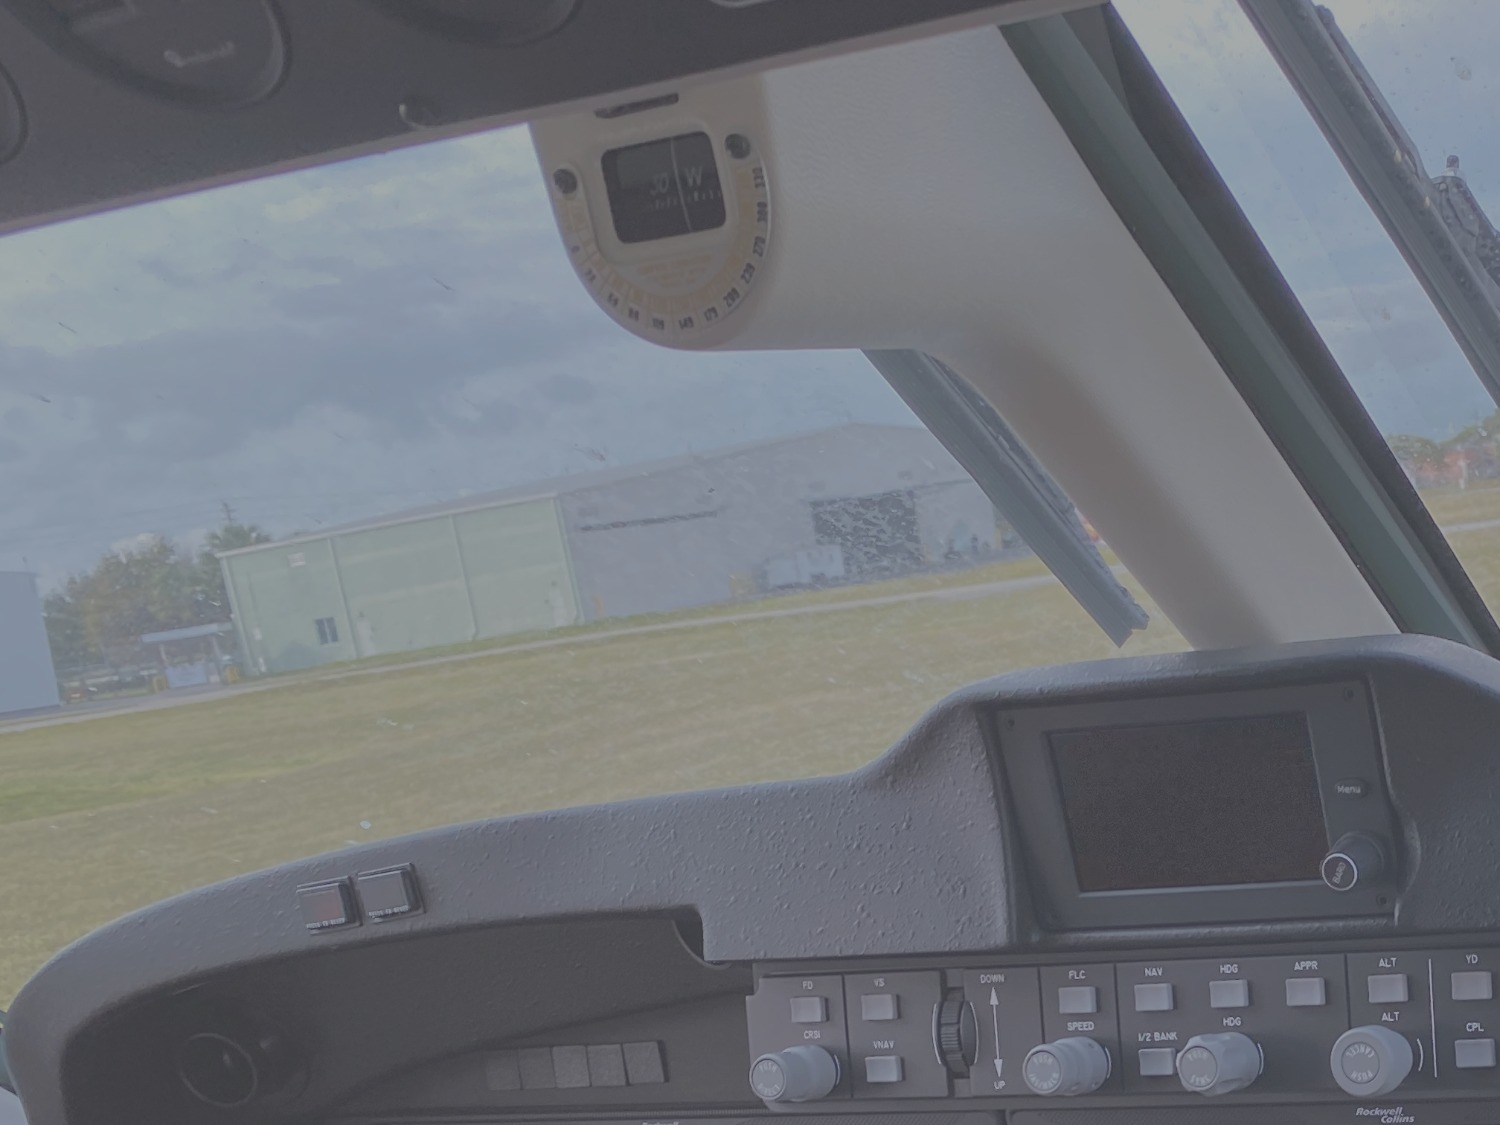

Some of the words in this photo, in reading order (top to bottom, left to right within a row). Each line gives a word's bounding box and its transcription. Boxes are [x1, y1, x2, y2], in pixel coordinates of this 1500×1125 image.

[1378, 958, 1397, 968] ALT
[1465, 955, 1479, 965] YD
[1219, 964, 1239, 975] HDG
[1294, 961, 1319, 971] APPR
[1068, 970, 1086, 981] FLC
[1144, 967, 1163, 977] NAV
[980, 973, 1005, 984] DOWN
[1223, 1017, 1242, 1027] HDG
[1381, 1011, 1400, 1022] ALT
[1067, 1021, 1095, 1032] SPEED
[1466, 1022, 1484, 1033] CPL
[873, 1040, 896, 1050] VNAV
[1356, 1107, 1403, 1119] Rockwell
[1380, 1113, 1415, 1125] Collins
